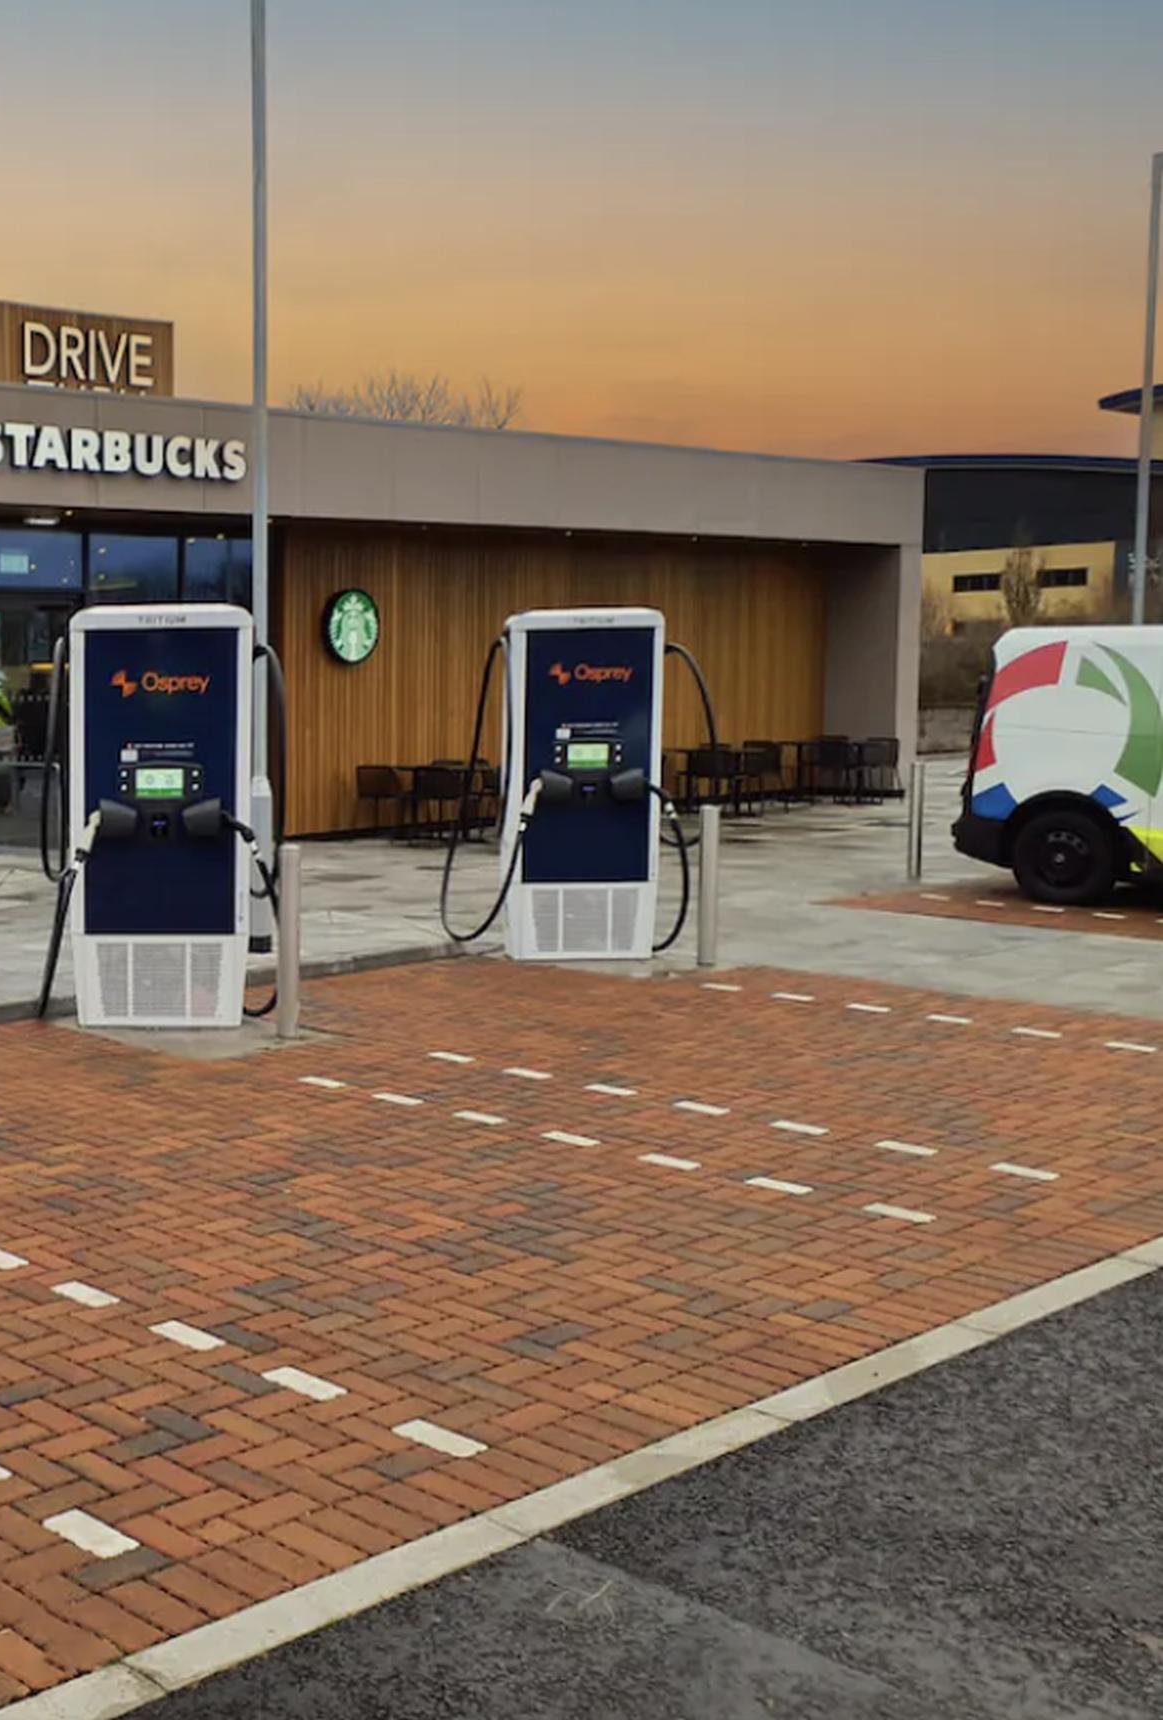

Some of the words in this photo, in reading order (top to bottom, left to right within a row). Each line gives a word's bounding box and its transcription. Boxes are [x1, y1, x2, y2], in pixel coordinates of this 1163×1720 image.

[24, 322, 153, 386] DRIVE
[142, 672, 210, 694] Osprey
[575, 664, 632, 682] Osprey
